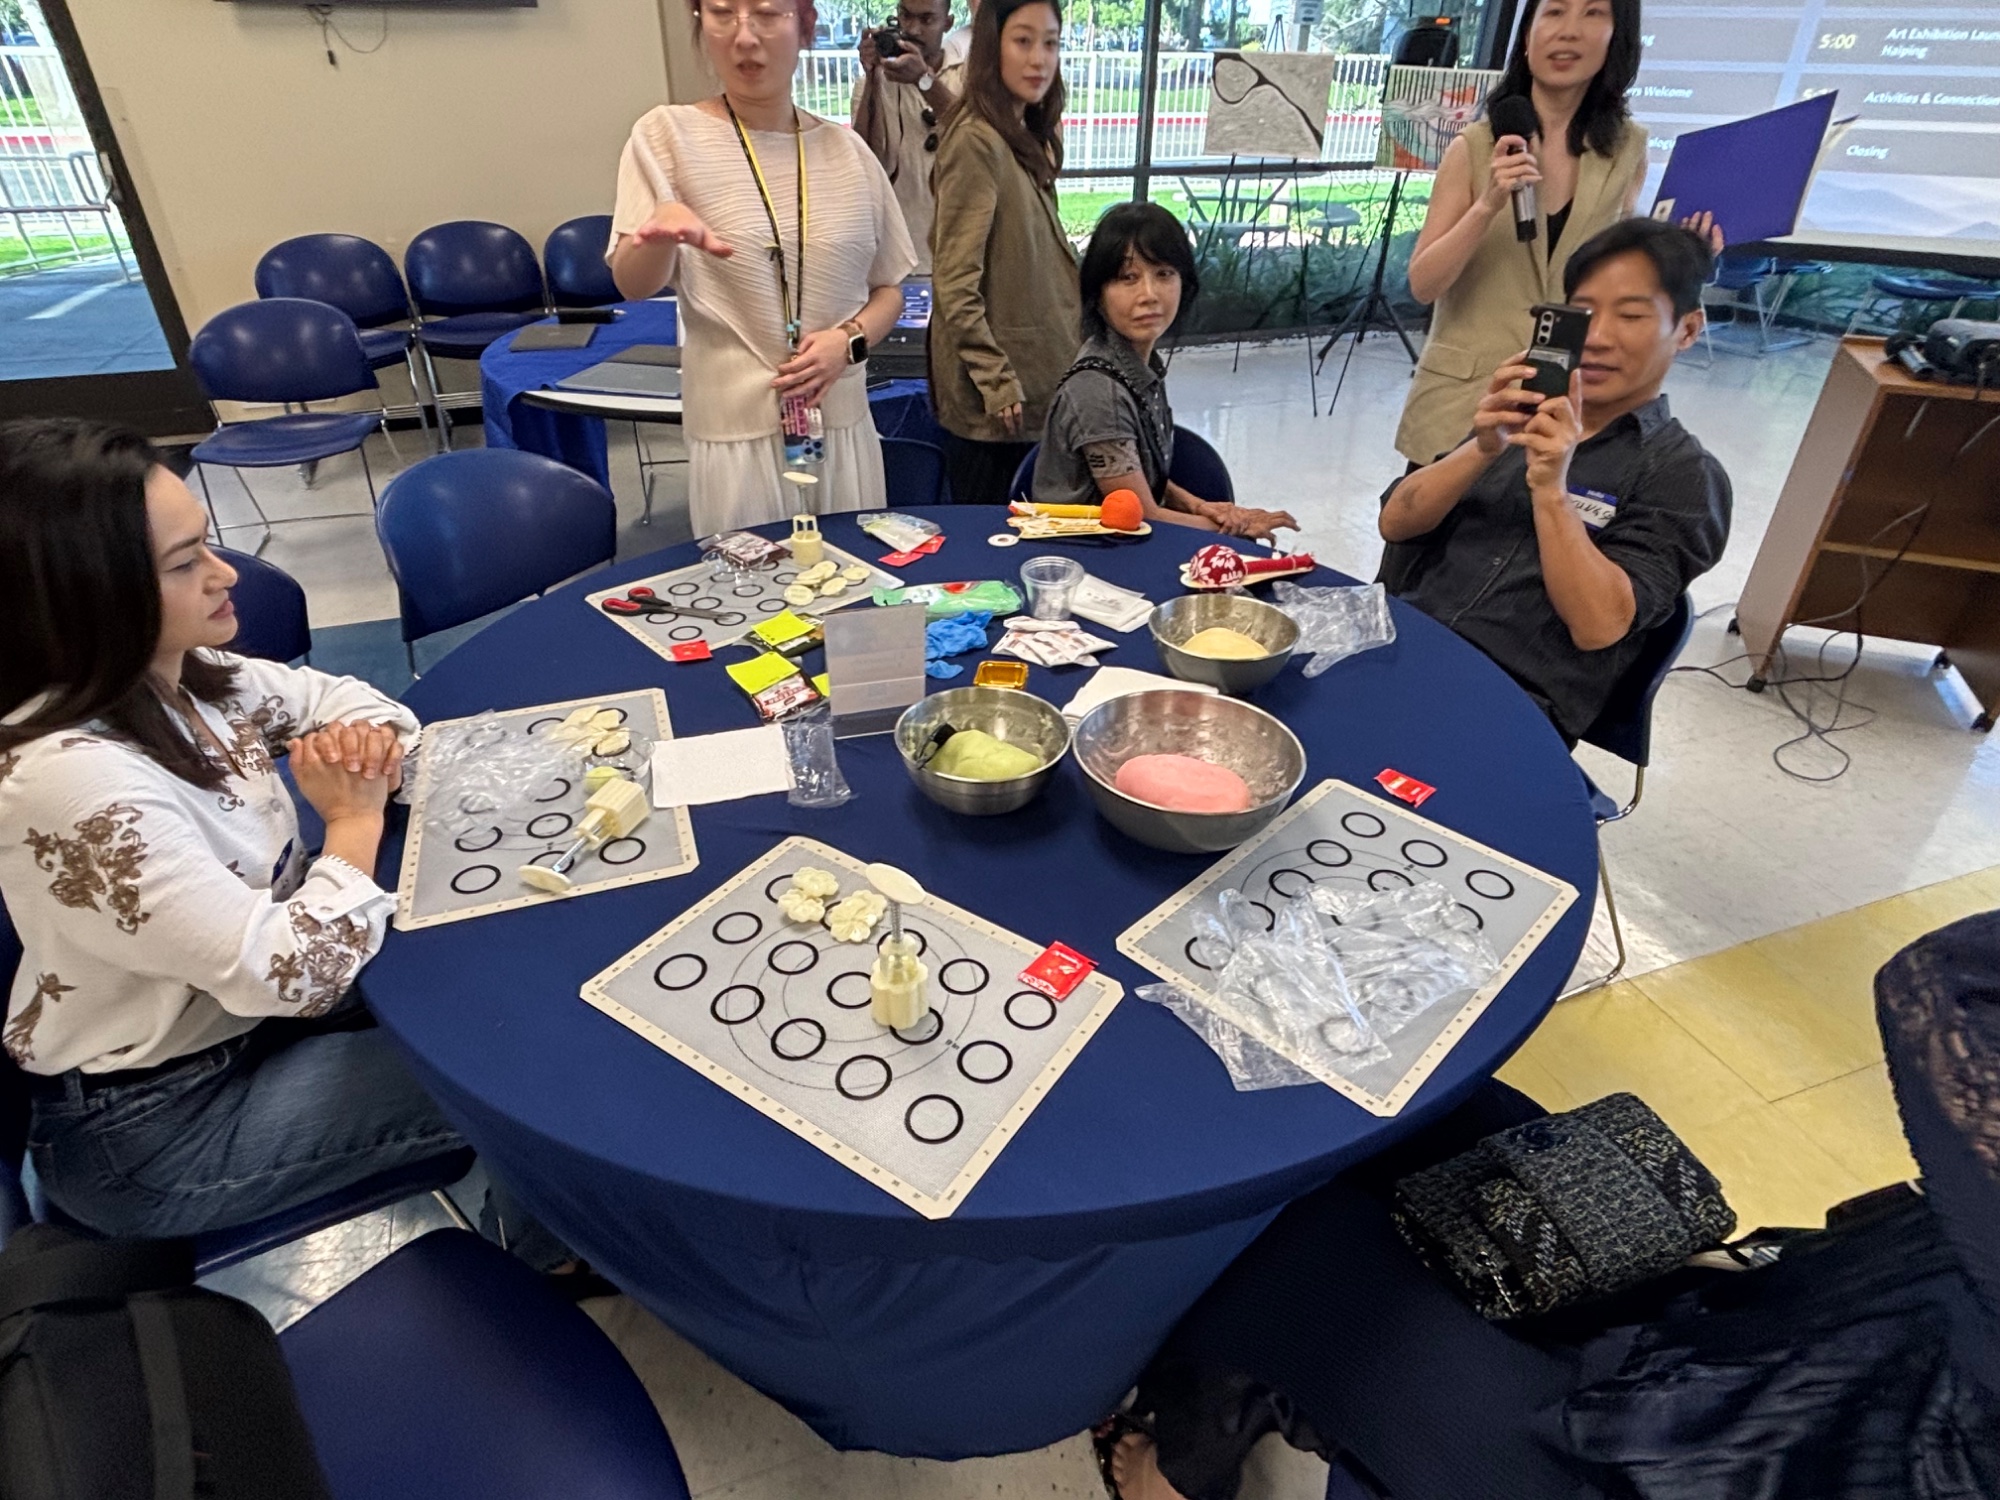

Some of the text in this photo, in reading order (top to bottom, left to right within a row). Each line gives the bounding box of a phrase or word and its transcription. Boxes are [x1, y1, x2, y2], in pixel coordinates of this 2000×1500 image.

[1886, 28, 1908, 40] Art
[1908, 28, 1968, 40] Exhibition
[1819, 33, 1857, 49] 5:00
[1881, 45, 1928, 59] Haiping
[1644, 86, 1693, 98] Welcome
[1863, 91, 1920, 104] Activities
[1920, 92, 1932, 104] &
[1845, 145, 1889, 159] Closing
